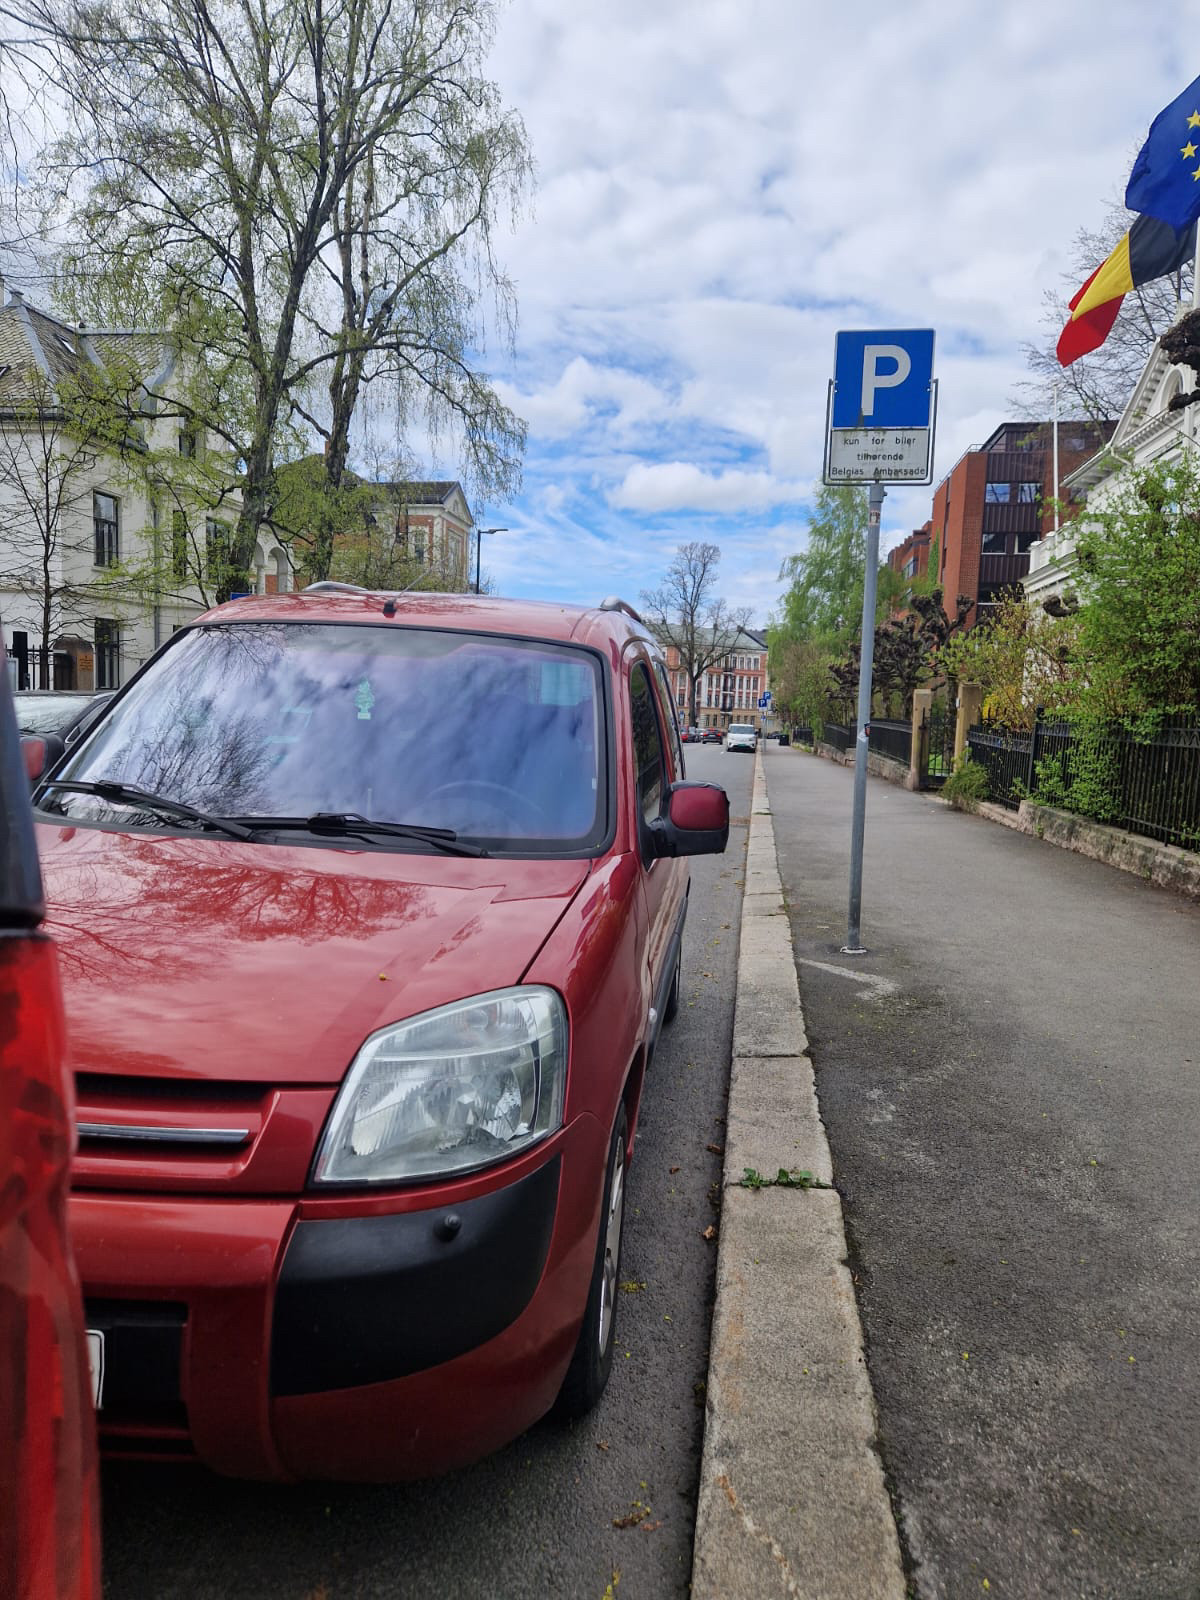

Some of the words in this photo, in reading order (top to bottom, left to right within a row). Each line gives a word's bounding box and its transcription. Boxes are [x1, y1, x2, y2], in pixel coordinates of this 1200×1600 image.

[861, 345, 911, 416] P
[843, 437, 860, 445] kun
[871, 437, 885, 445] for
[831, 467, 864, 477] Belgias
[873, 467, 925, 476] Ambassade
